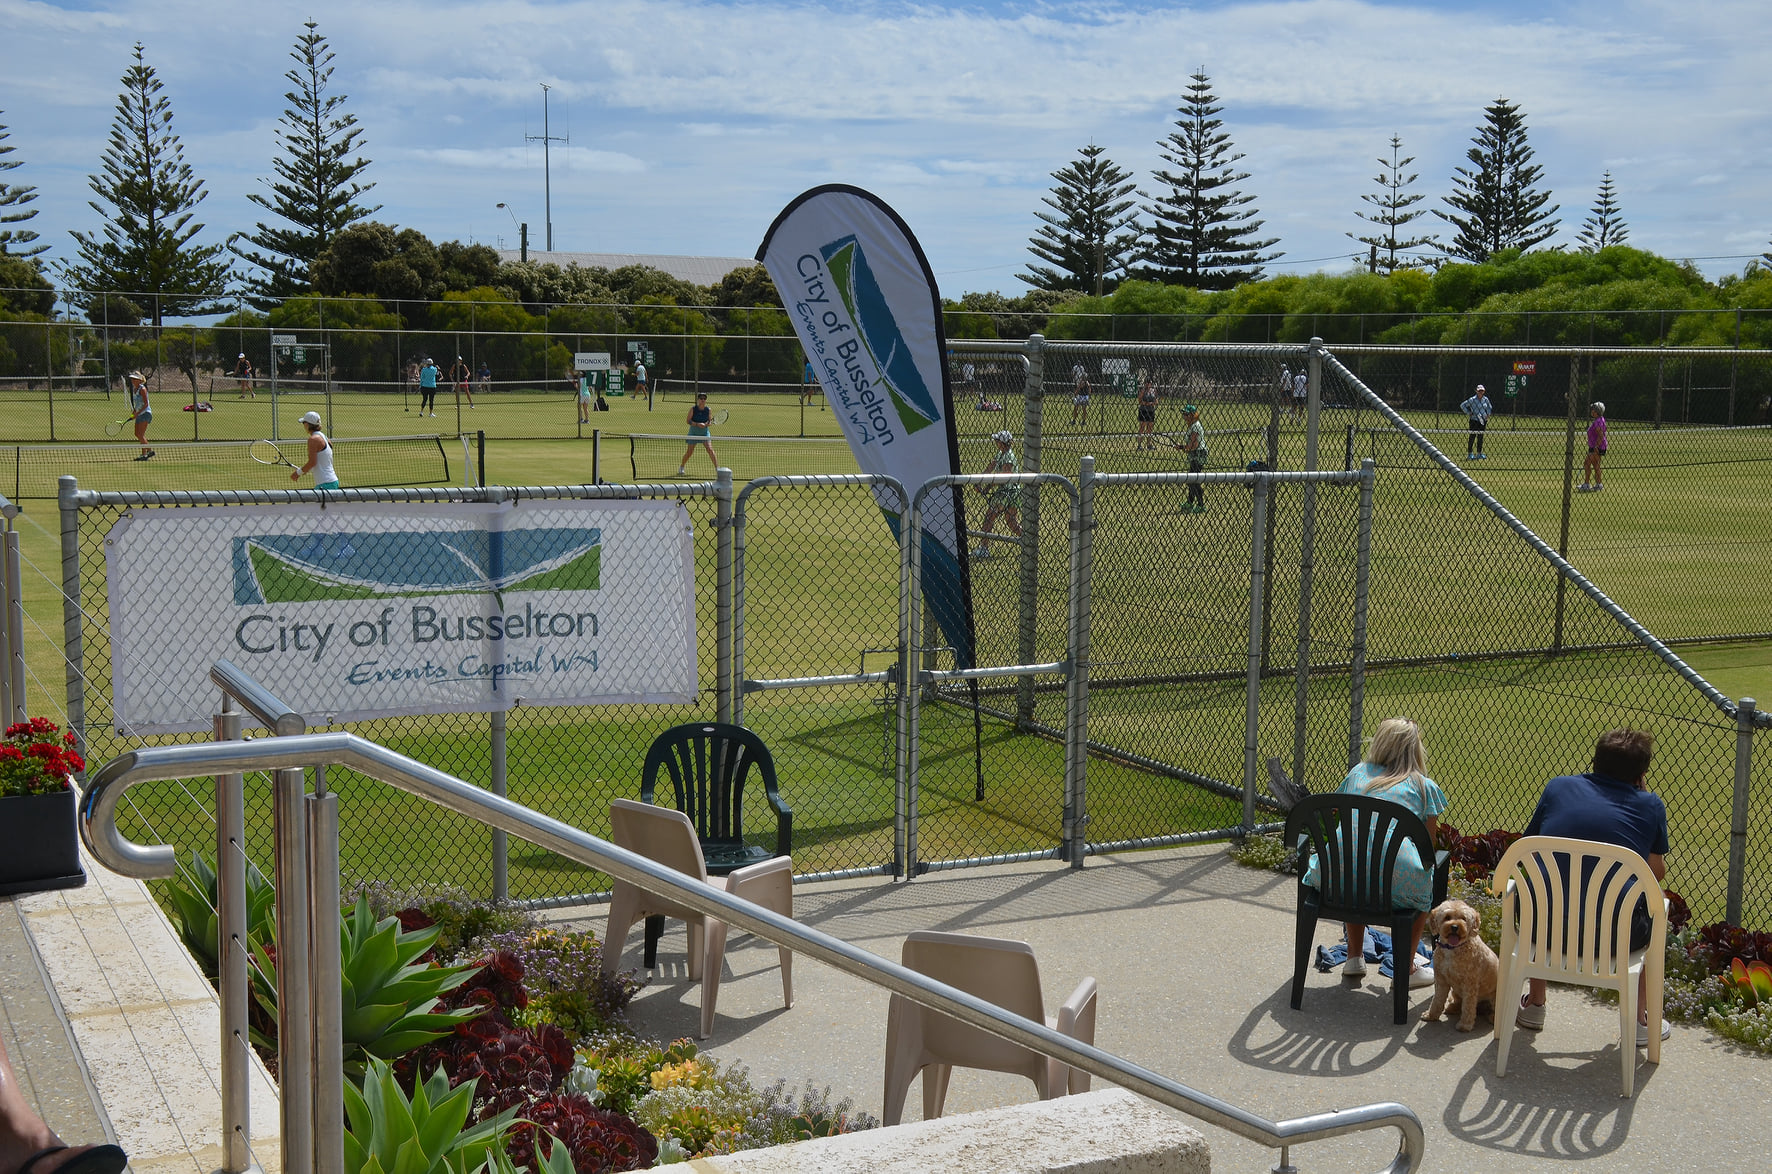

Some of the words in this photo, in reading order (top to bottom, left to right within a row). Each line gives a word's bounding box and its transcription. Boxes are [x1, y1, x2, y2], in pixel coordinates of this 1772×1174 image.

[634, 351, 642, 359] 14
[796, 253, 830, 304] City
[822, 310, 850, 335] of
[836, 338, 895, 447] Busselton
[796, 301, 825, 355] Events
[824, 358, 858, 410] Capital
[849, 411, 876, 446] WA
[590, 371, 598, 385] 7
[235, 614, 335, 663] City
[348, 606, 395, 647] of
[411, 602, 600, 643] Busselton
[345, 660, 448, 686] Events
[457, 646, 546, 691] Capital
[550, 649, 600, 674] WA
